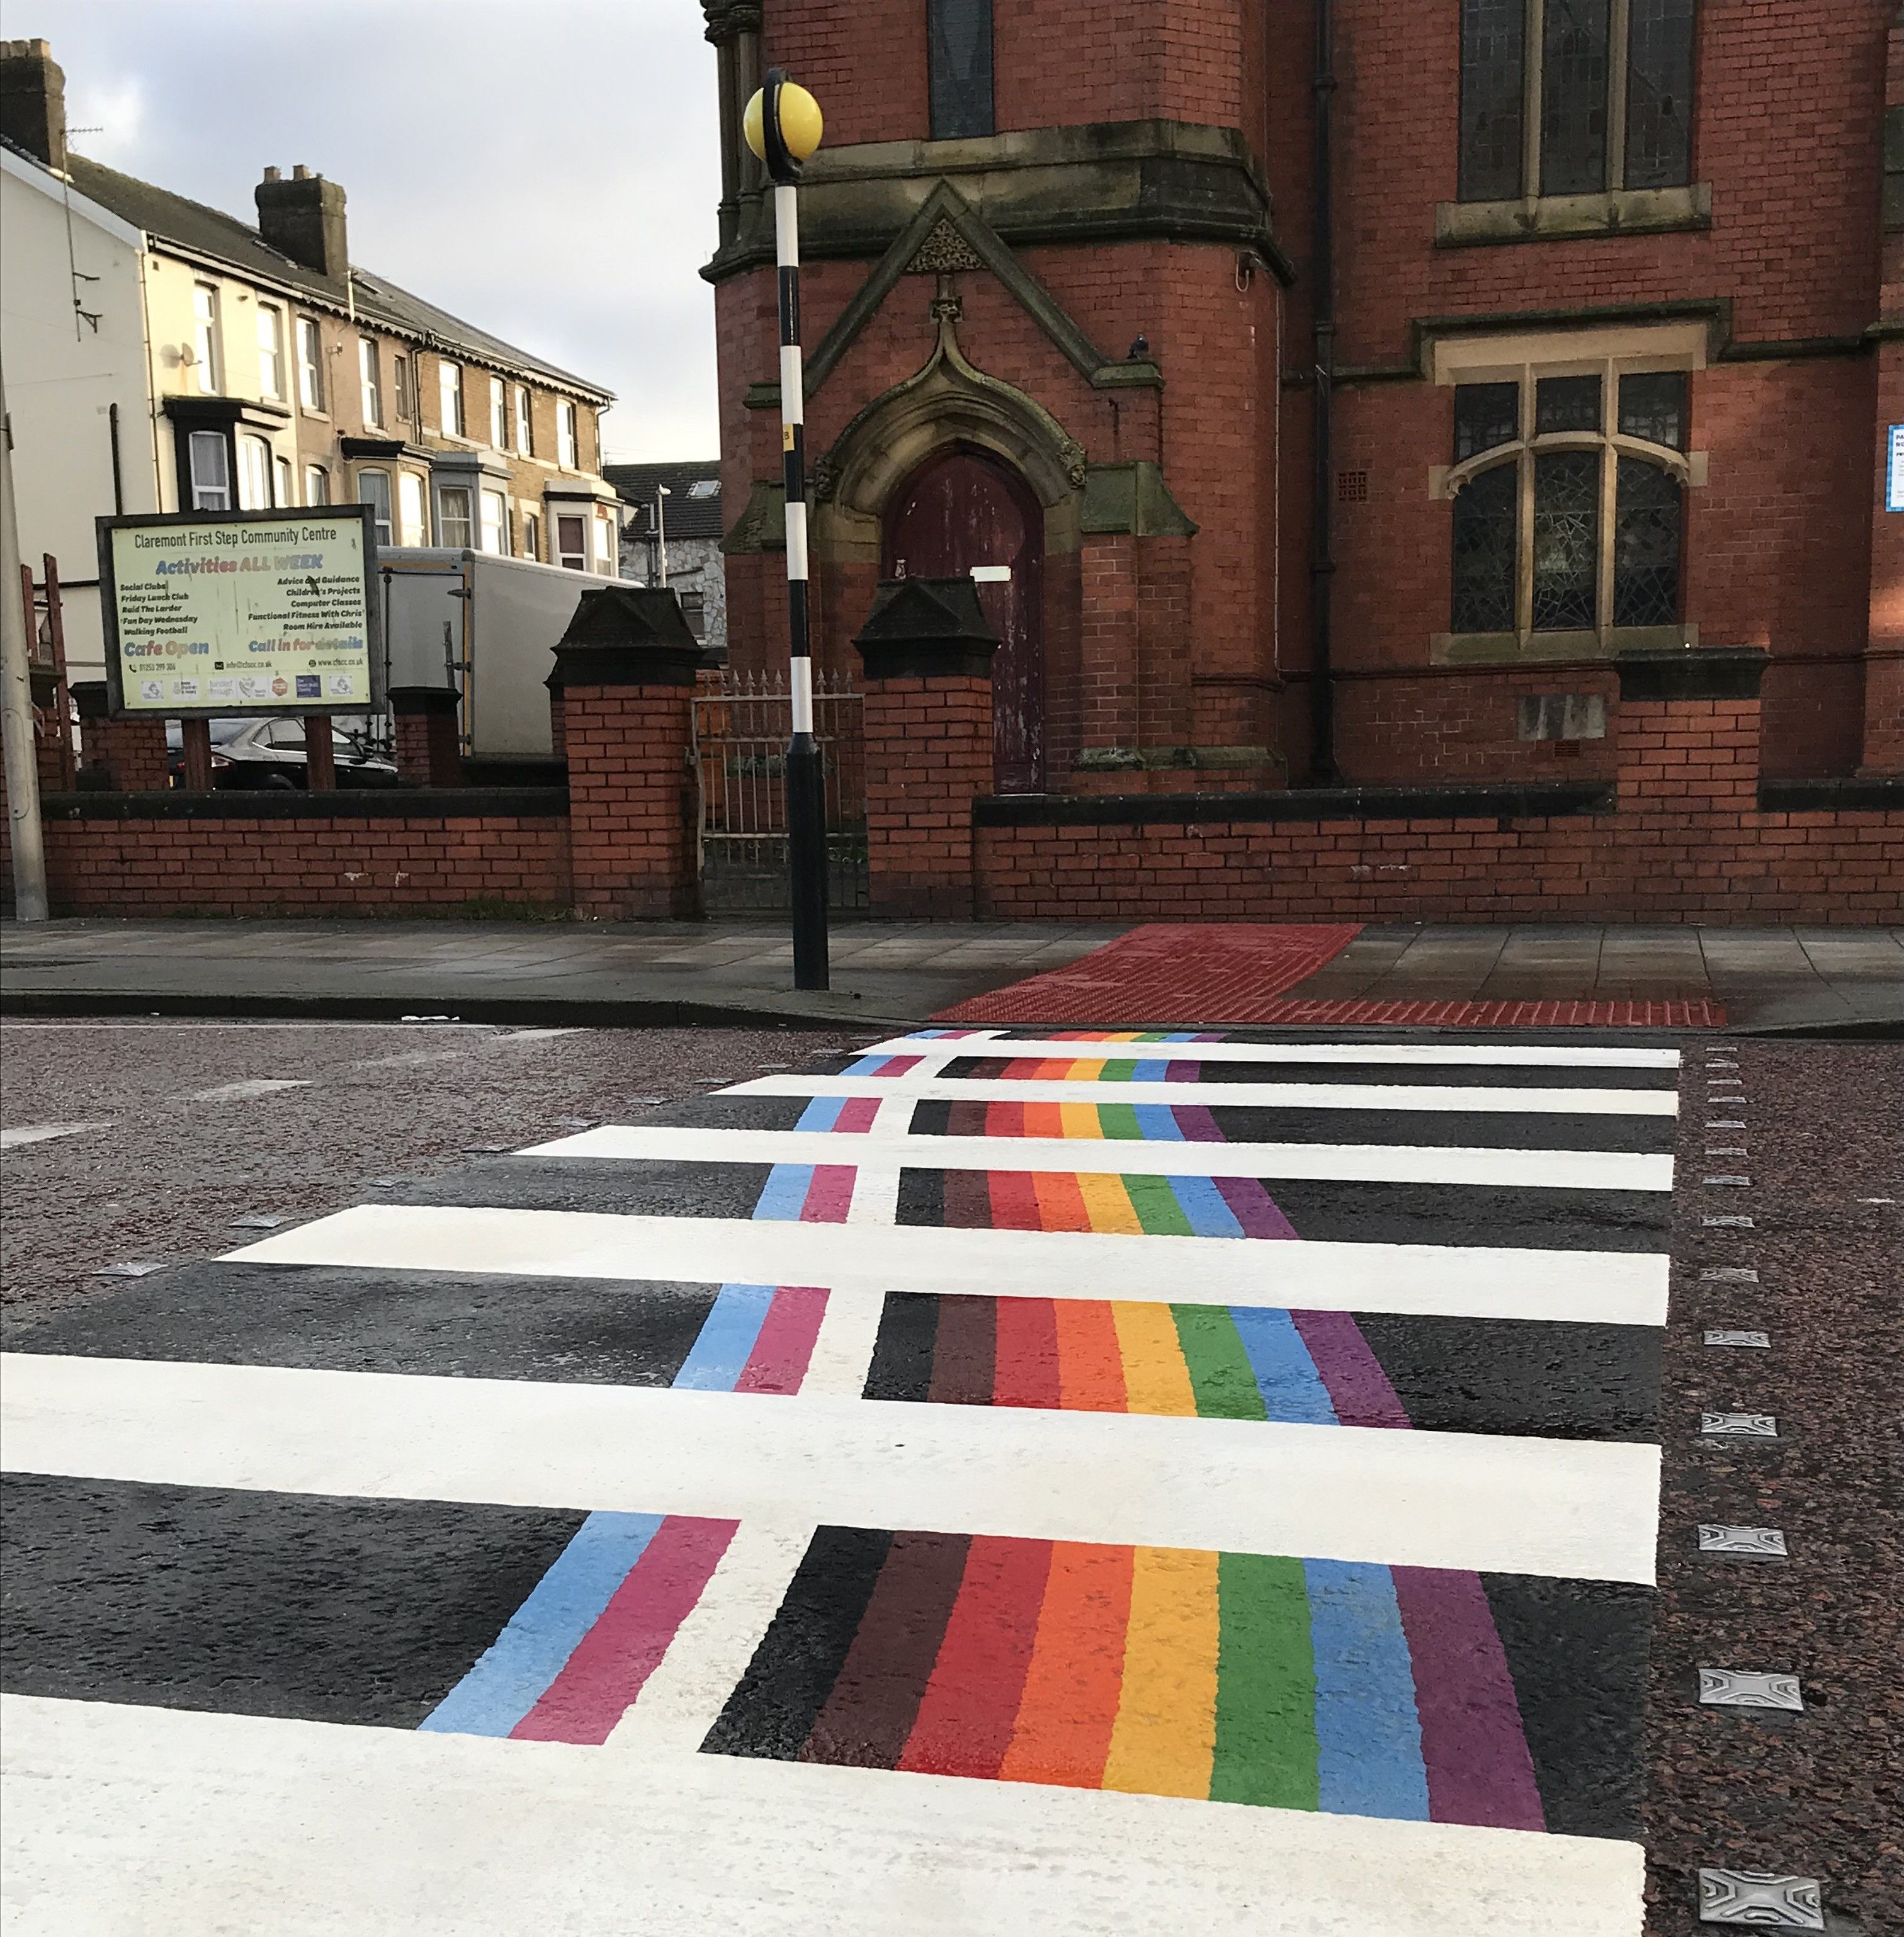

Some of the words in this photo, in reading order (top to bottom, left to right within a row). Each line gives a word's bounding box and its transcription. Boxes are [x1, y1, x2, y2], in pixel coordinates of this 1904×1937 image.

[135, 534, 187, 548] Claremont
[189, 531, 213, 546] First
[215, 530, 238, 548] Step
[241, 528, 299, 545] Community
[302, 526, 337, 541] Centre
[156, 556, 237, 575] Activities
[239, 556, 271, 572] ALL
[273, 553, 324, 570] WEEK
[277, 577, 303, 585] Advice
[322, 575, 360, 584] Guidance
[120, 583, 144, 591] Social
[144, 582, 166, 590] Clubs
[327, 587, 361, 596] Projects
[122, 594, 147, 603] Friday
[122, 605, 140, 613] Raid
[156, 604, 183, 613] Larder
[291, 600, 331, 608] Computer
[139, 616, 154, 625] Day
[154, 615, 198, 624] Wednesday
[248, 612, 290, 620] Functional
[324, 621, 363, 629] Available
[124, 628, 155, 636] Walking
[156, 626, 188, 635] Football
[249, 639, 276, 652] Call
[277, 638, 292, 651] in
[293, 638, 315, 651] for
[315, 636, 363, 650] details
[124, 640, 163, 657] Cafe
[165, 640, 210, 659] Open
